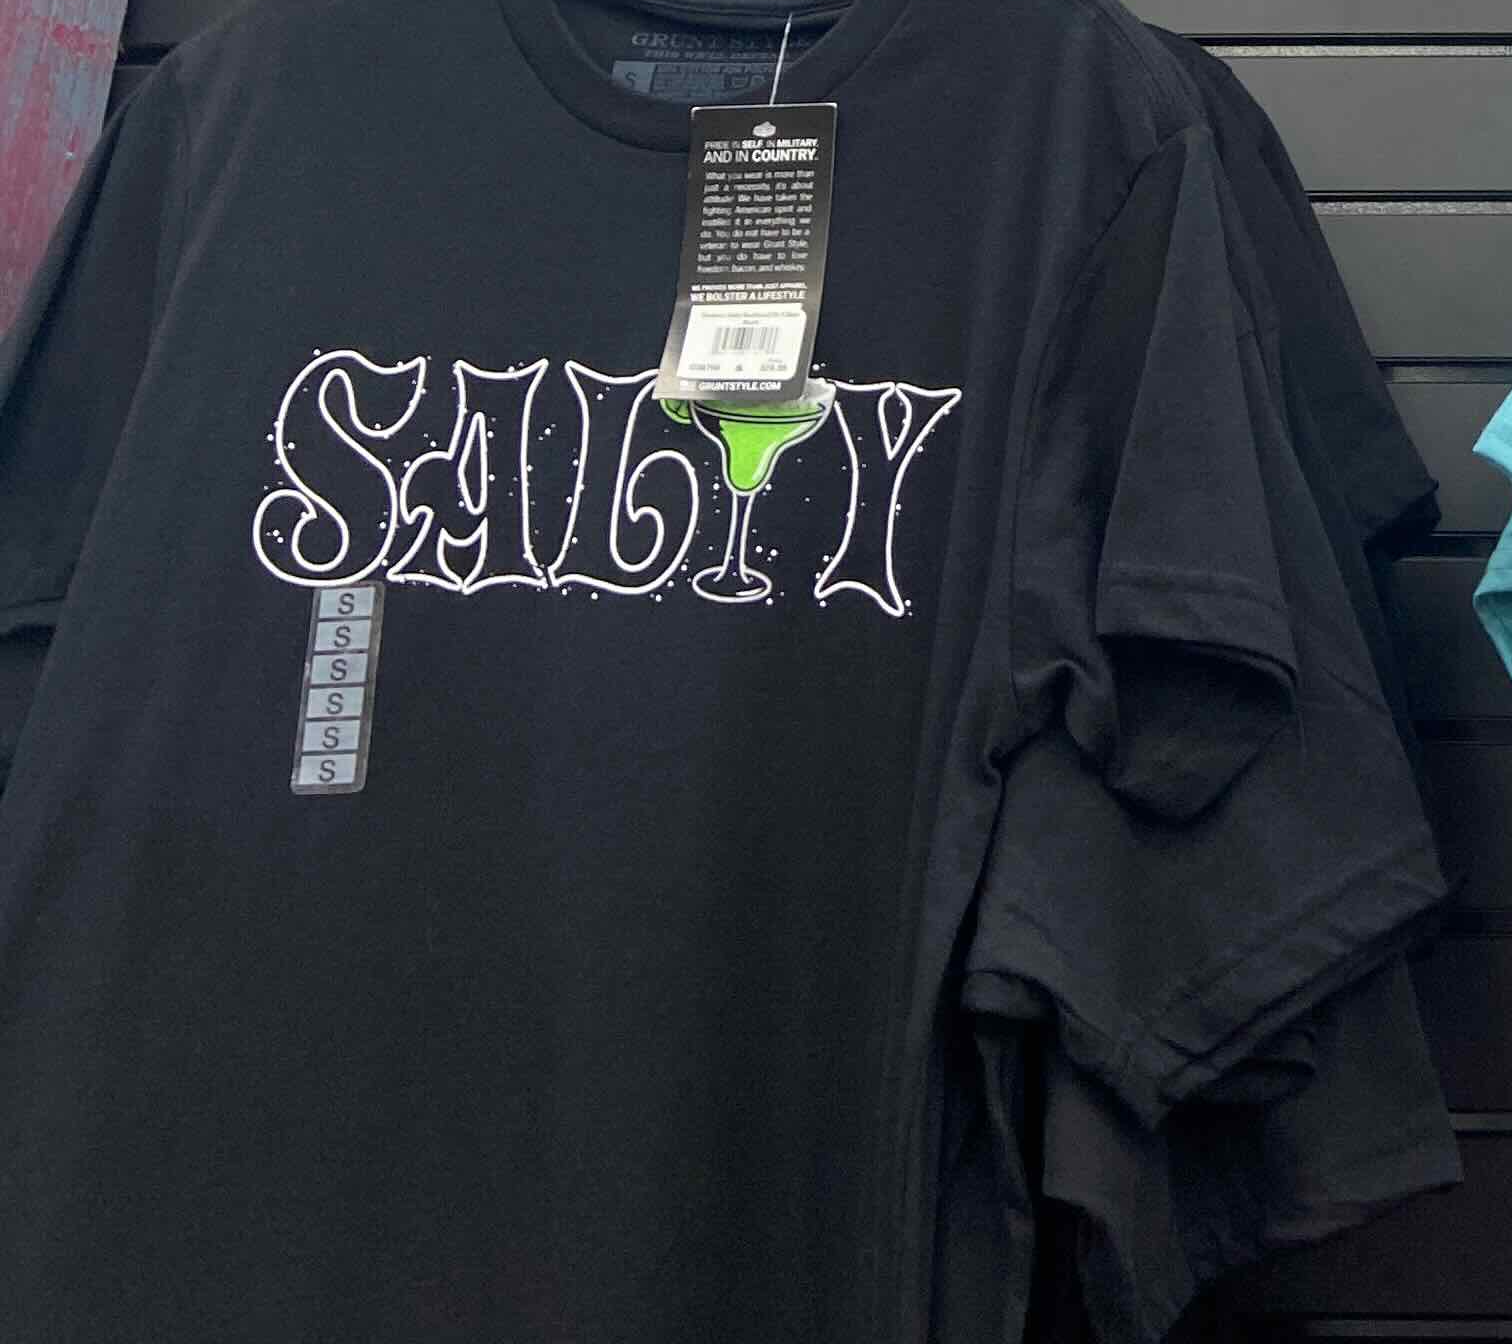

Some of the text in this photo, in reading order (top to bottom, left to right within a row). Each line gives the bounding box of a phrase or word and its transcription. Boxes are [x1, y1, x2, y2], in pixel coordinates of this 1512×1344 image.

[703, 150, 732, 163] AND
[735, 149, 749, 162] IN
[253, 349, 963, 617] SALTY
[338, 593, 355, 615] S
[334, 626, 351, 648] S
[330, 659, 347, 681] S
[326, 692, 343, 715] S
[322, 726, 339, 749] S
[318, 759, 336, 782] S
